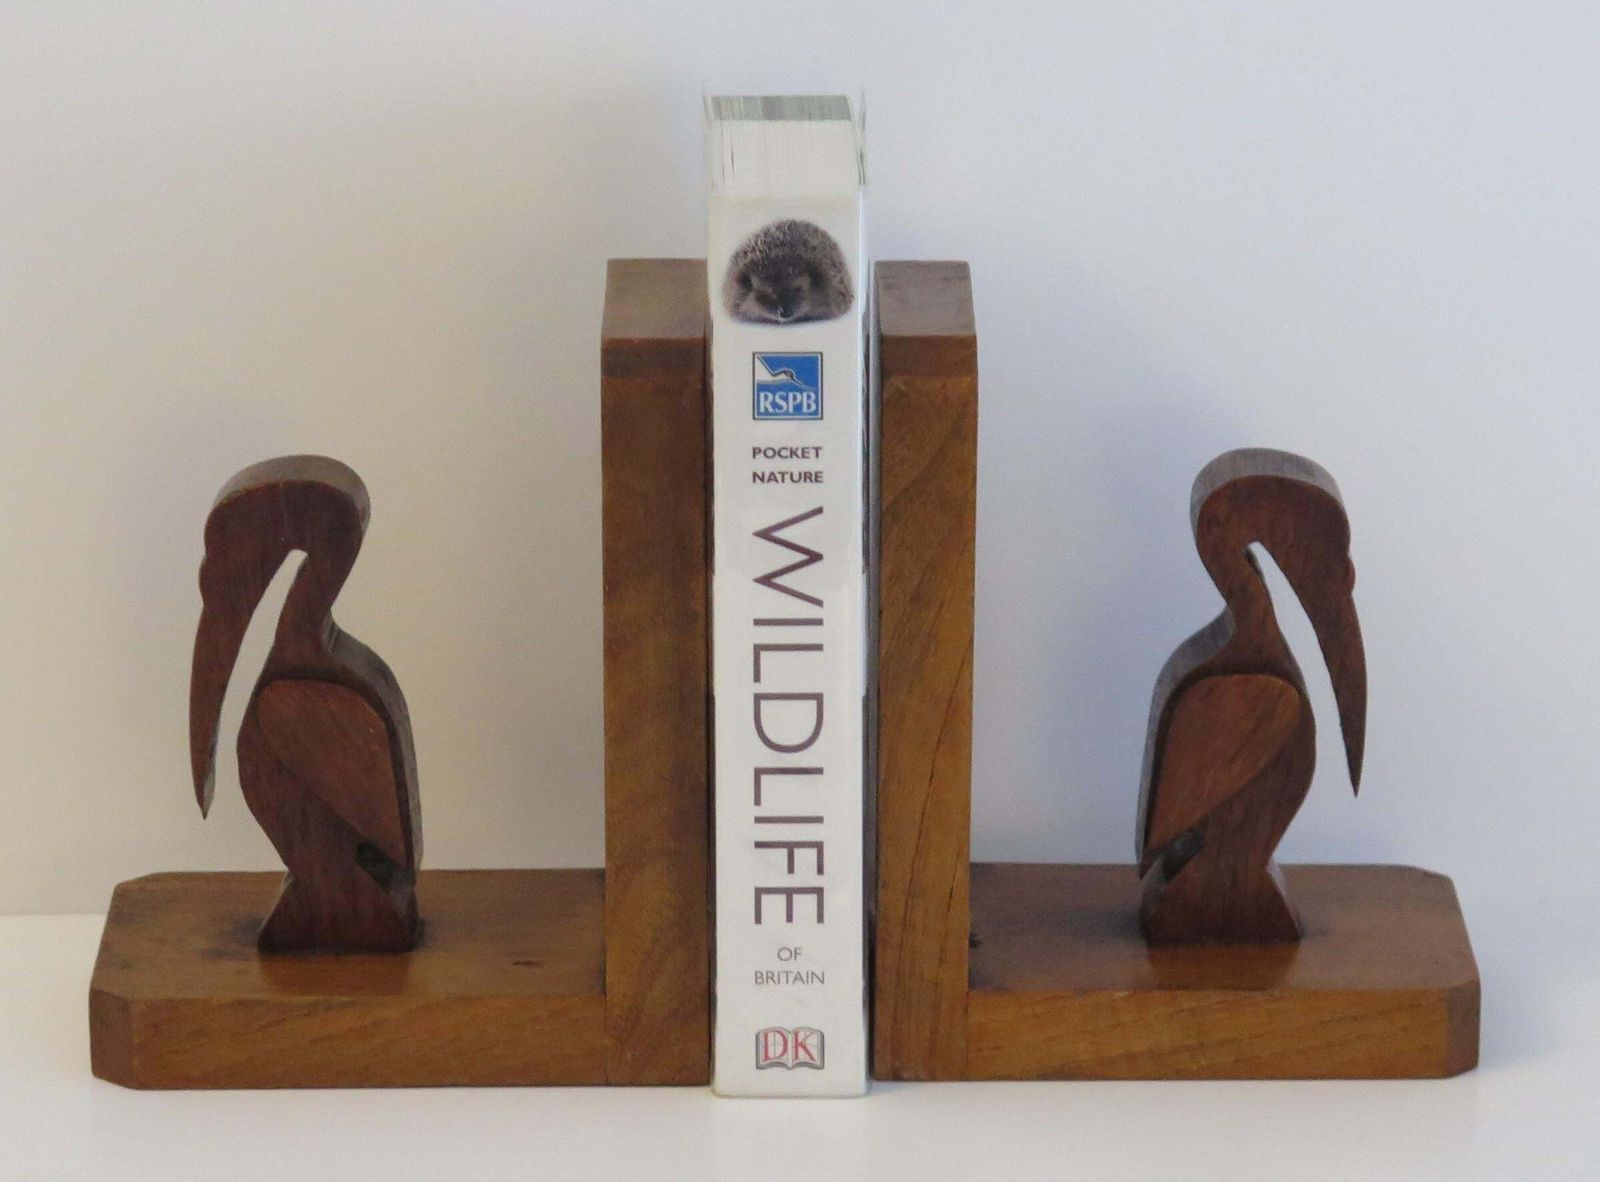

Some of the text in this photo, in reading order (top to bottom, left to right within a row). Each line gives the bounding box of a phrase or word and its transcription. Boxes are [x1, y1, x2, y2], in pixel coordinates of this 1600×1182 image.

[759, 391, 817, 413] RSPB
[752, 446, 822, 459] POCKET
[752, 471, 824, 484] NATURE
[752, 505, 824, 925] WILDLIFE
[777, 947, 803, 961] OF
[754, 970, 825, 985] BRITAIN
[761, 1030, 817, 1062] DK
